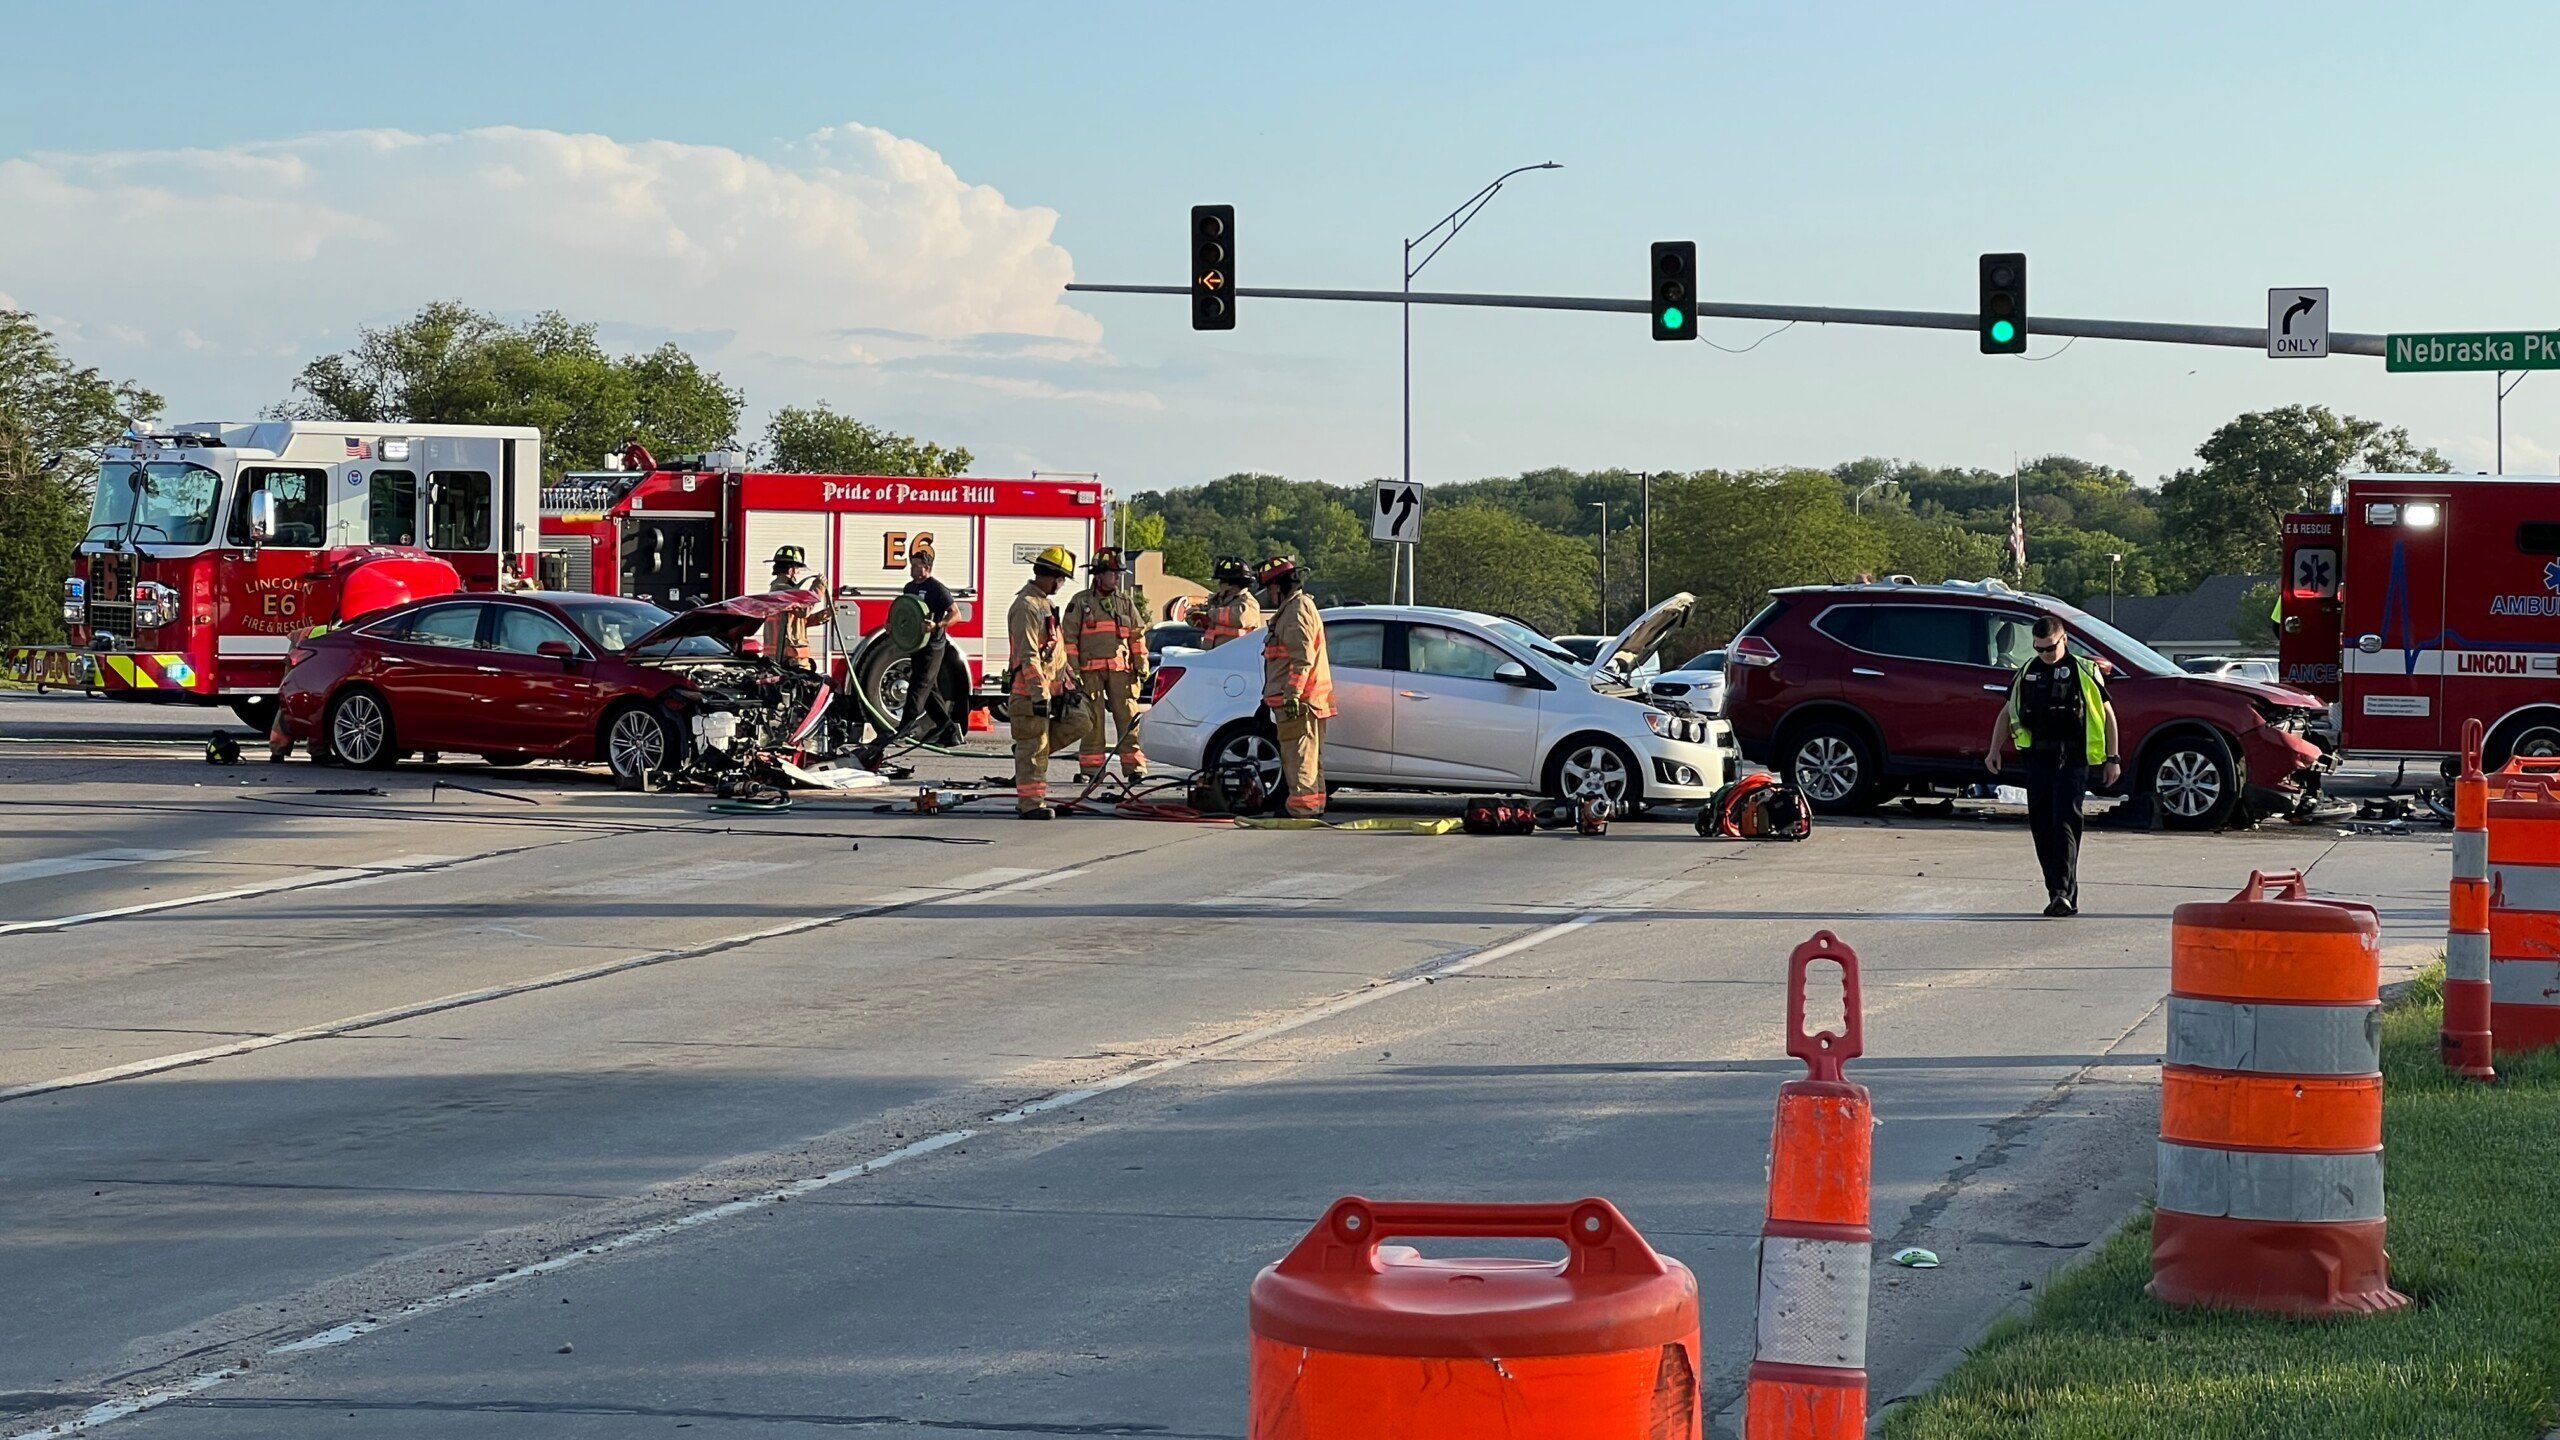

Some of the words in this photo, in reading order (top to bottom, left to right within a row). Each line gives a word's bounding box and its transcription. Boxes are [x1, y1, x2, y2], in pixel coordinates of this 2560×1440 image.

[2276, 338, 2319, 352] ONLY
[2396, 336, 2514, 363] Nebraska
[822, 481, 871, 503] Pride
[875, 482, 893, 502] of
[895, 483, 959, 504] Peanut
[962, 485, 996, 504] Hill
[2300, 523, 2332, 534] RESCUE
[882, 531, 936, 570] E6
[245, 577, 314, 596] LINCOLN
[263, 593, 296, 616] E6
[241, 614, 266, 632] FIRE
[276, 615, 315, 633] RESCUE
[2457, 653, 2528, 674] LINCOLN
